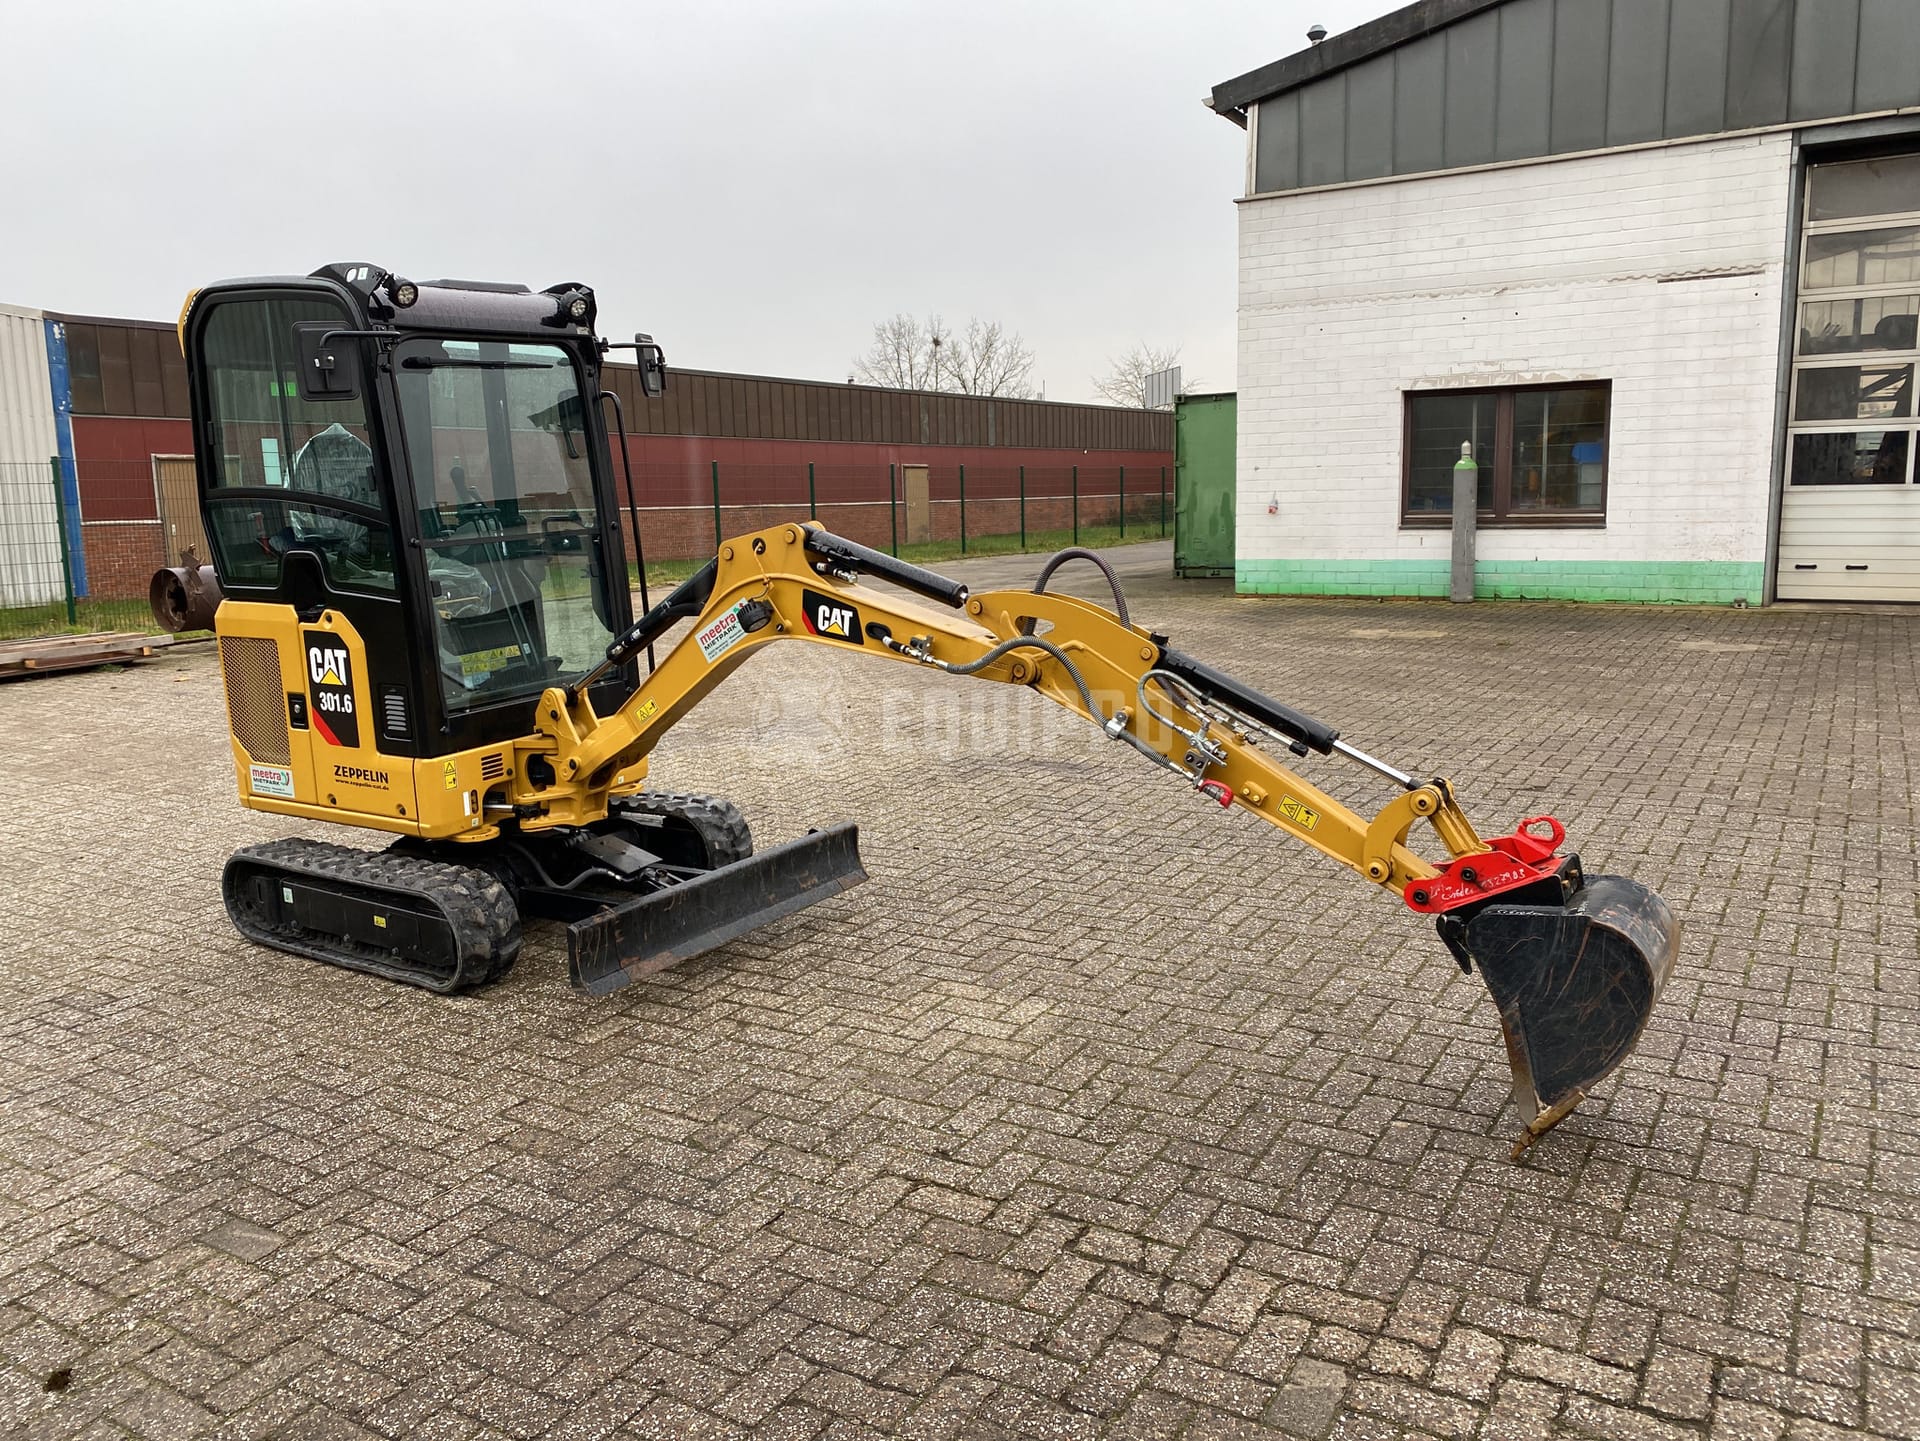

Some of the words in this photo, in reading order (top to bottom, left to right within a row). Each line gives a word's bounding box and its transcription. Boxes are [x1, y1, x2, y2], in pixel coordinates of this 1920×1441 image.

[700, 613, 737, 646] meetra
[817, 604, 854, 637] CAT
[703, 623, 738, 651] MIETPARK
[309, 646, 347, 686] CAT
[318, 691, 353, 714] 301.6
[252, 769, 282, 781] meetra
[333, 764, 389, 785] ZEPPELIN
